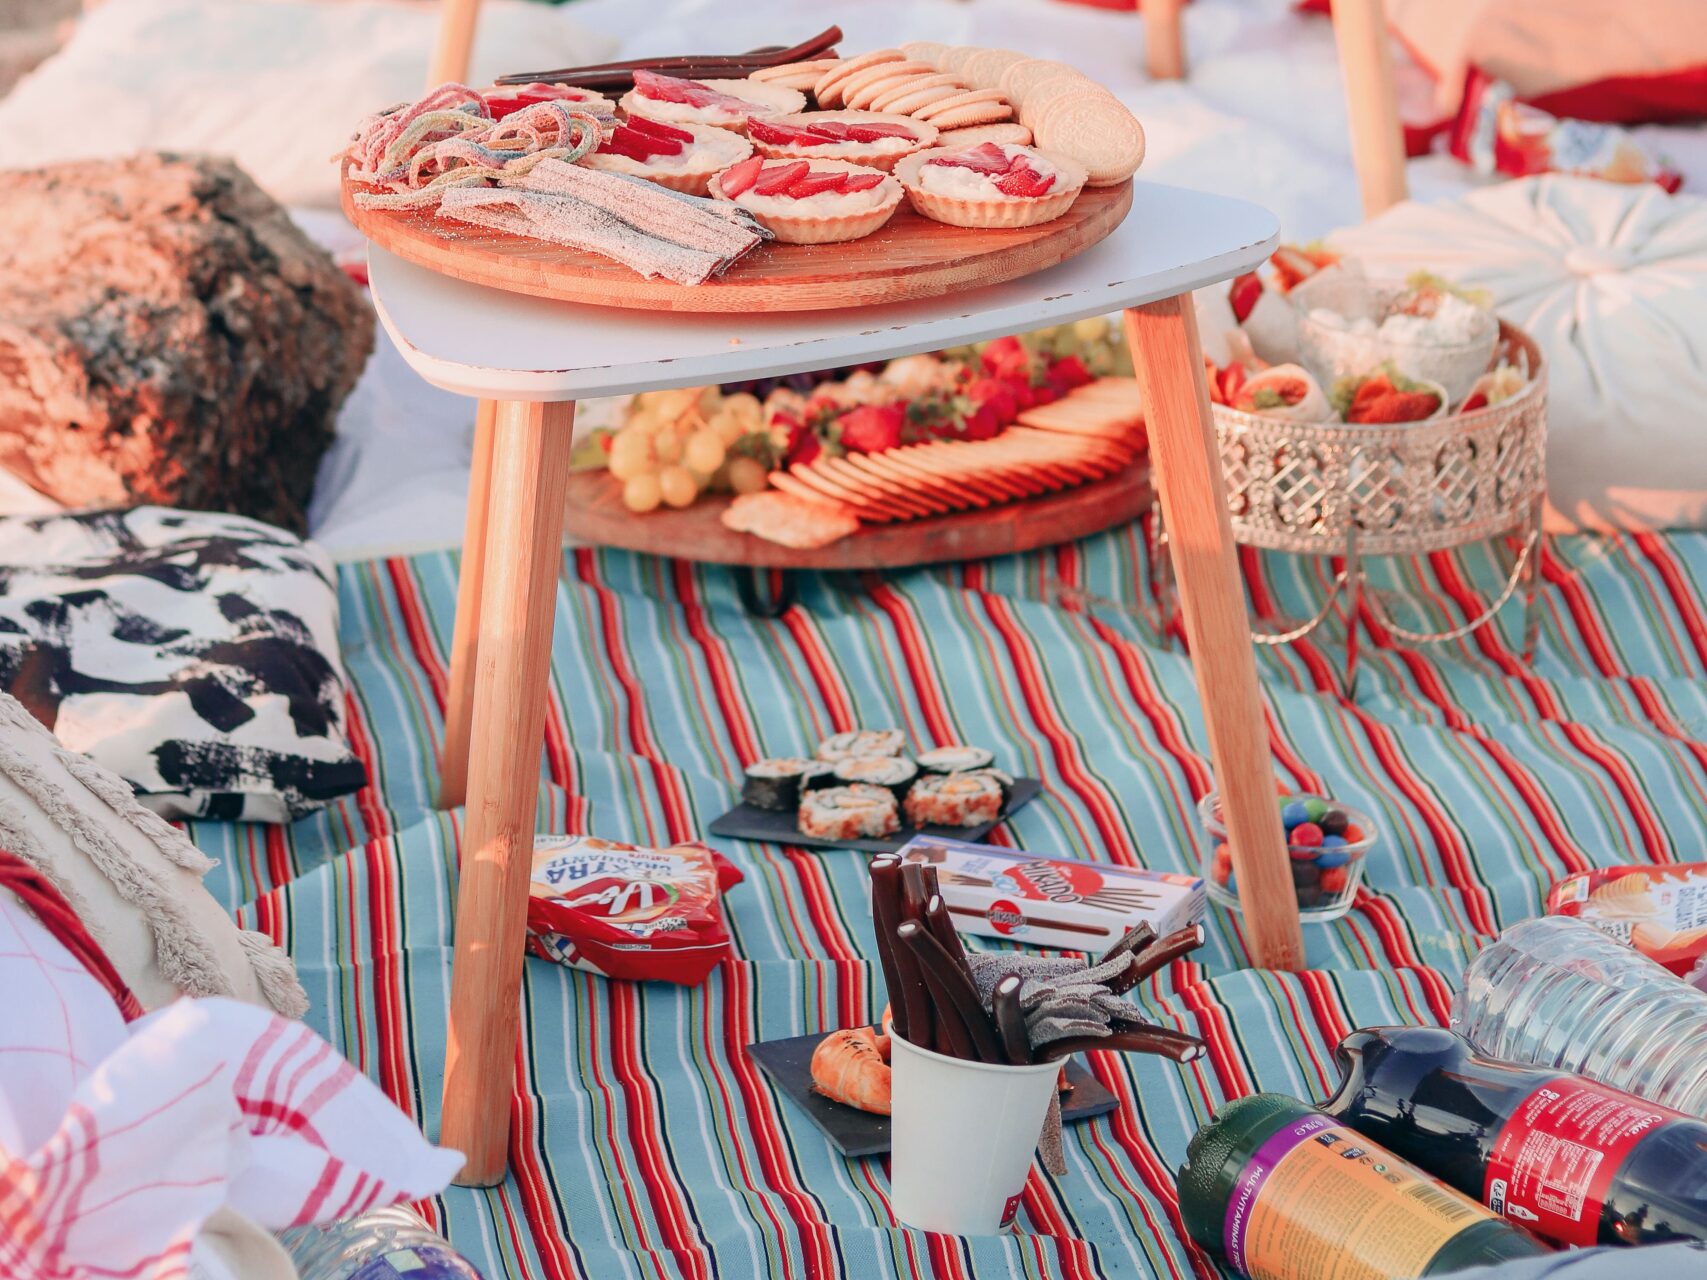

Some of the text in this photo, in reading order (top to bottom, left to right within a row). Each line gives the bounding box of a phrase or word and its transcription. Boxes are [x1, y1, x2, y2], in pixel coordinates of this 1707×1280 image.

[1016, 859, 1079, 904] MIKADO
[986, 909, 1026, 926] MIKADO
[1630, 1114, 1663, 1135] Coke
[1231, 1165, 1264, 1249] MULTIVITAMINAS
